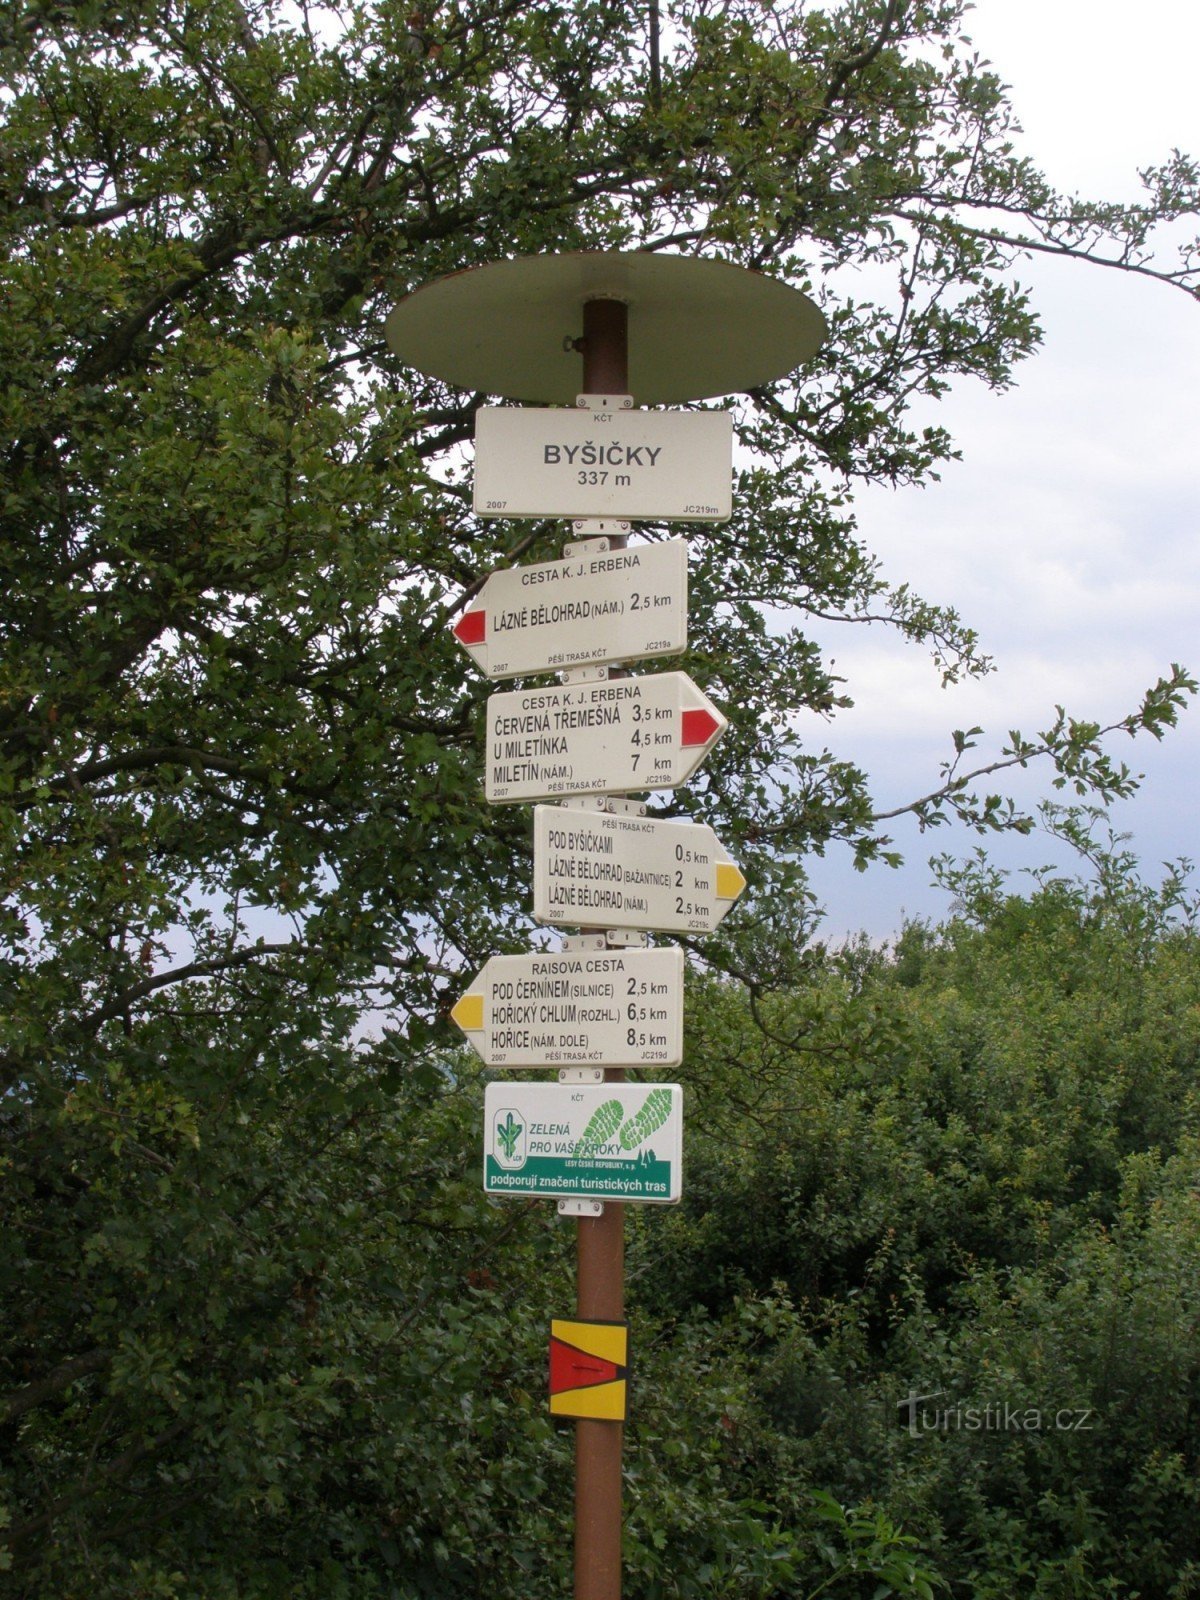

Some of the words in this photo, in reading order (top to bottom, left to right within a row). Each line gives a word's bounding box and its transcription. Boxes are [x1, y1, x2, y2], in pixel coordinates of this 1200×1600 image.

[594, 413, 613, 422] KČT
[544, 441, 662, 466] BYŠIČKY
[578, 471, 608, 486] 337
[615, 474, 631, 486] m
[486, 501, 507, 509] 2007
[683, 505, 719, 514] JC219m
[522, 568, 559, 586] CESTA
[563, 567, 574, 578] K.
[577, 564, 586, 576] J.
[591, 555, 640, 574] ERBENA
[494, 608, 527, 632] LÁZNĚ
[531, 601, 591, 626] BĚLOHRAD
[654, 595, 671, 607] km
[644, 641, 671, 650] JC219a
[548, 655, 564, 664] PĚŠÍ
[566, 652, 590, 661] TRASA
[592, 649, 607, 659] KČT
[493, 663, 508, 672] 2007
[522, 695, 559, 710] CESTA
[563, 694, 574, 705] K.
[578, 692, 587, 703] J.
[591, 686, 641, 702] ERBENA
[495, 711, 550, 736] ČERVENÁ
[554, 704, 621, 730] TŘEMEŠNÁ
[655, 707, 673, 720] km
[494, 743, 501, 760] U
[505, 736, 568, 759] MILETÍNKA
[654, 732, 672, 745] km
[493, 760, 539, 783] MILETÍN
[632, 754, 640, 772] 7
[654, 758, 671, 769] km
[548, 783, 564, 792] PĚŠÍ
[566, 781, 591, 791] TRASA
[592, 779, 607, 788] KČT
[645, 775, 671, 784] JC219b
[493, 788, 509, 796] 2007
[602, 820, 618, 829] PĚŠÍ
[619, 822, 640, 832] TRASA
[642, 824, 655, 833] KČT
[549, 830, 566, 849] POD
[569, 830, 613, 854] BYŠIČKAMI
[694, 854, 709, 864] km
[549, 854, 576, 878] LÁZNĚ
[578, 859, 622, 882] BĚLOHRAD
[675, 870, 683, 888] 2
[695, 879, 709, 890] km
[549, 882, 576, 906] LÁZNĚ
[578, 887, 622, 910] BĚLOHRAD
[695, 906, 709, 916] km
[549, 910, 564, 918] 2007
[687, 920, 709, 929] JC219c
[532, 961, 583, 976] RAISOVA
[586, 959, 624, 973] CESTA
[492, 983, 513, 1001] POD
[516, 977, 570, 999] ČERNÍNEM
[651, 983, 668, 994] km
[492, 1002, 536, 1025] HOŘICKÝ
[540, 1004, 576, 1023] CHLUM
[650, 1009, 667, 1019] km
[492, 1027, 529, 1049] HOŘICE
[650, 1035, 667, 1045] km
[545, 1052, 562, 1061] PĚŠÍ
[563, 1052, 587, 1060] TRASA
[588, 1051, 603, 1060] KČT
[641, 1051, 667, 1060] JC219d
[571, 1094, 584, 1102] KČT
[529, 1122, 570, 1135] ZELENÁ
[529, 1142, 552, 1153] PRO
[554, 1141, 582, 1154] VAŠE
[585, 1144, 622, 1155] KROKY
[579, 1158, 594, 1168] ČESKÉ
[491, 1174, 537, 1188] podporují
[539, 1176, 578, 1188] značení
[581, 1177, 642, 1192] turistických
[645, 1182, 666, 1192] tras
